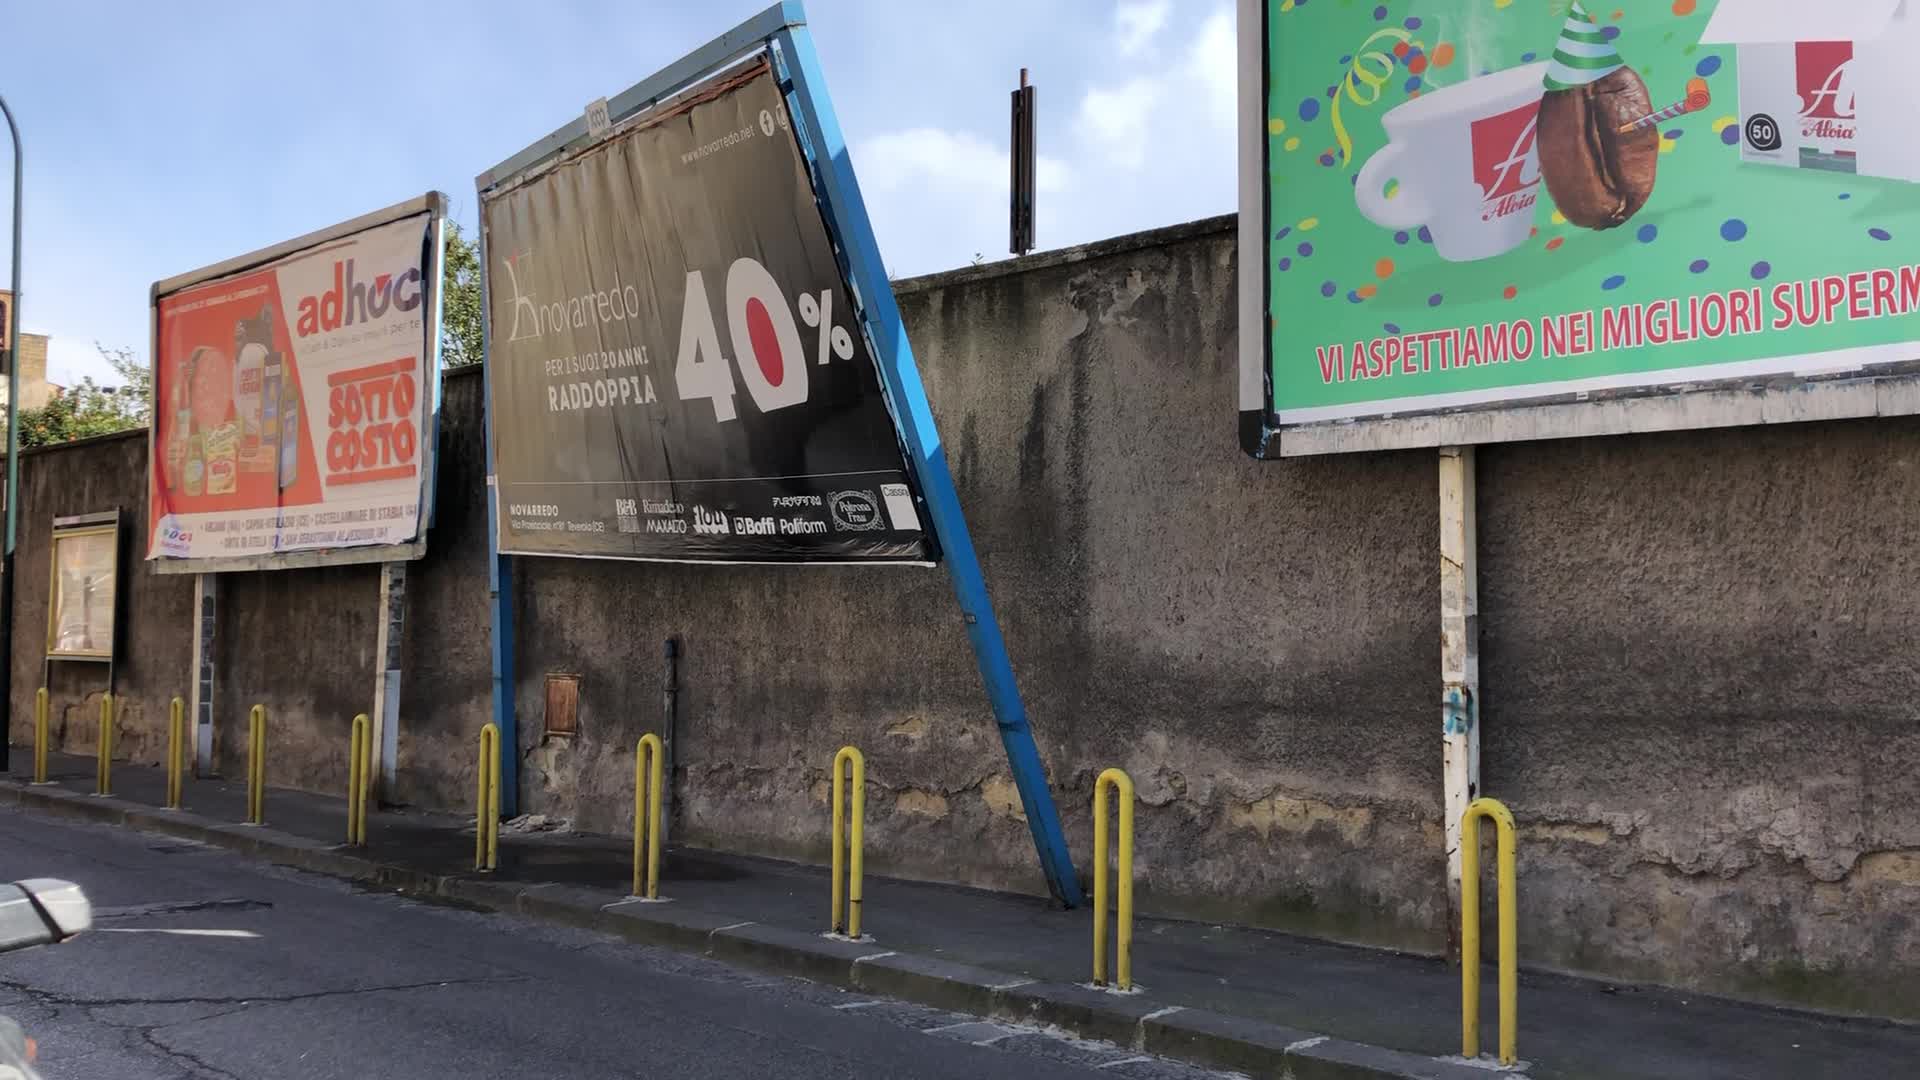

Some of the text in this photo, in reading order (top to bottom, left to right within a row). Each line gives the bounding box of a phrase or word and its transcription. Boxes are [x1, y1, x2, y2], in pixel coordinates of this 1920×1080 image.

[1752, 125, 1772, 140] 50
[297, 257, 421, 337] adhoc
[1316, 345, 1344, 383] VI
[1350, 318, 1535, 381] ASPETTIAMO
[1542, 311, 1594, 358] NEI
[1602, 286, 1763, 351] MIGLIORI
[545, 359, 564, 377] PER
[573, 352, 600, 373] SUOI
[601, 351, 617, 369] 20
[618, 345, 649, 368] ANNI
[328, 377, 416, 429] SOTTO
[547, 375, 657, 412] RADDOPPIA
[326, 421, 417, 473] COSTO
[510, 504, 559, 516] NOVARREDO
[745, 517, 828, 535] Boffi Poliform
